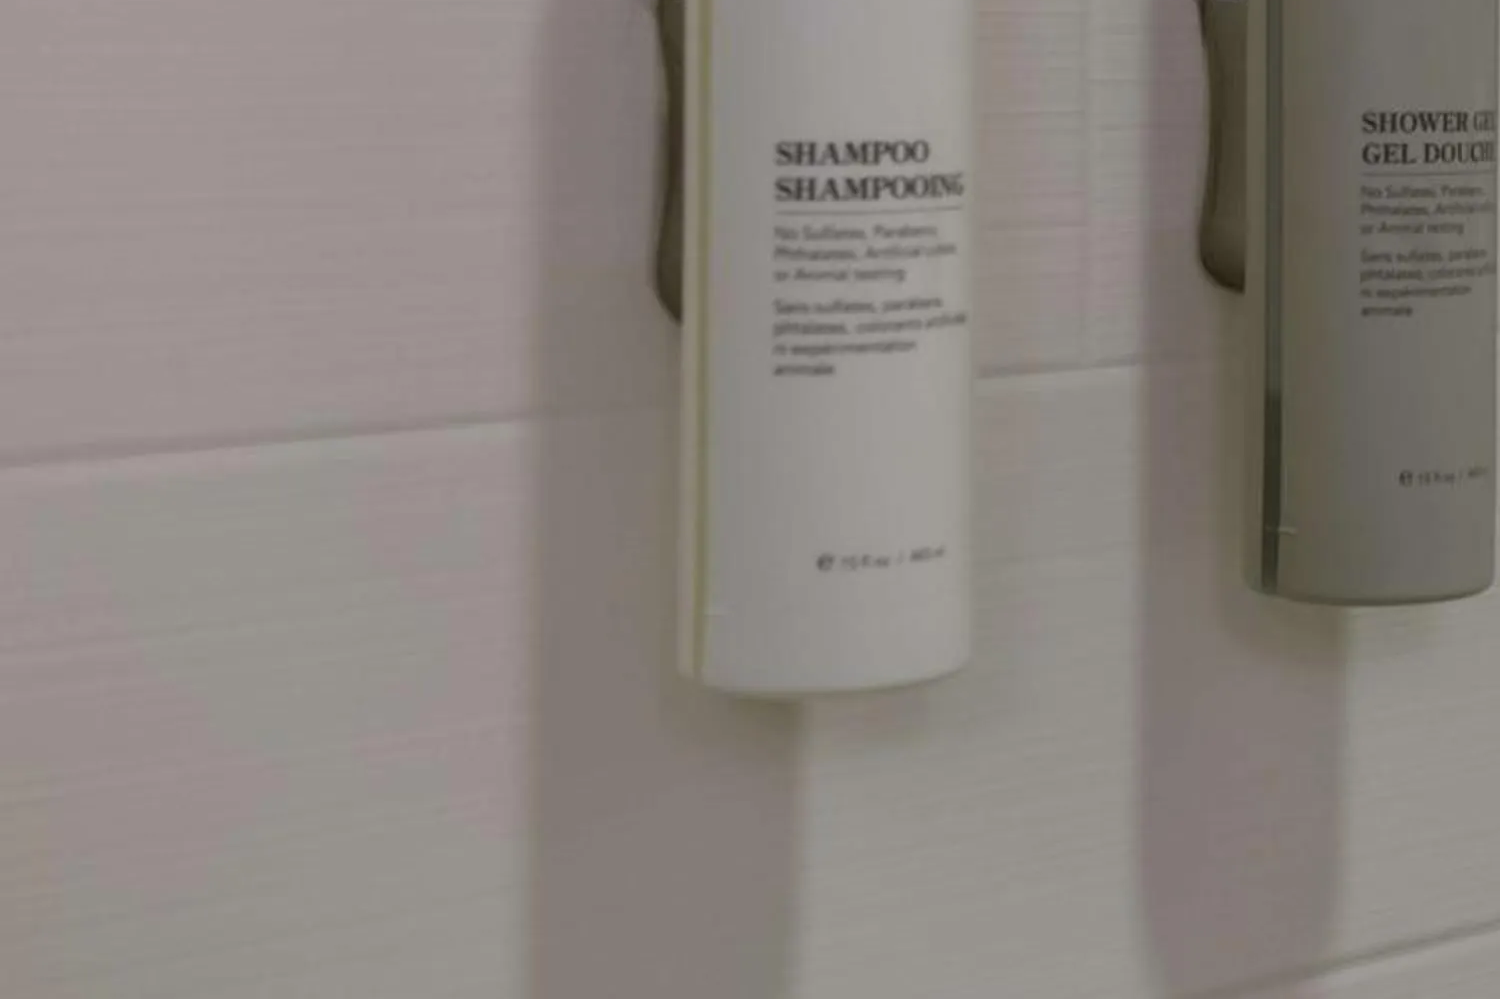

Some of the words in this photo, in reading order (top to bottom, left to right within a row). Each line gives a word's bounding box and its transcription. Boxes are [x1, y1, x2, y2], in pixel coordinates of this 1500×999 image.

[1361, 111, 1469, 134] SHOWER
[774, 139, 931, 166] SHAMPOO
[1361, 142, 1417, 165] GEL
[774, 172, 965, 202] SHAMPOOING
